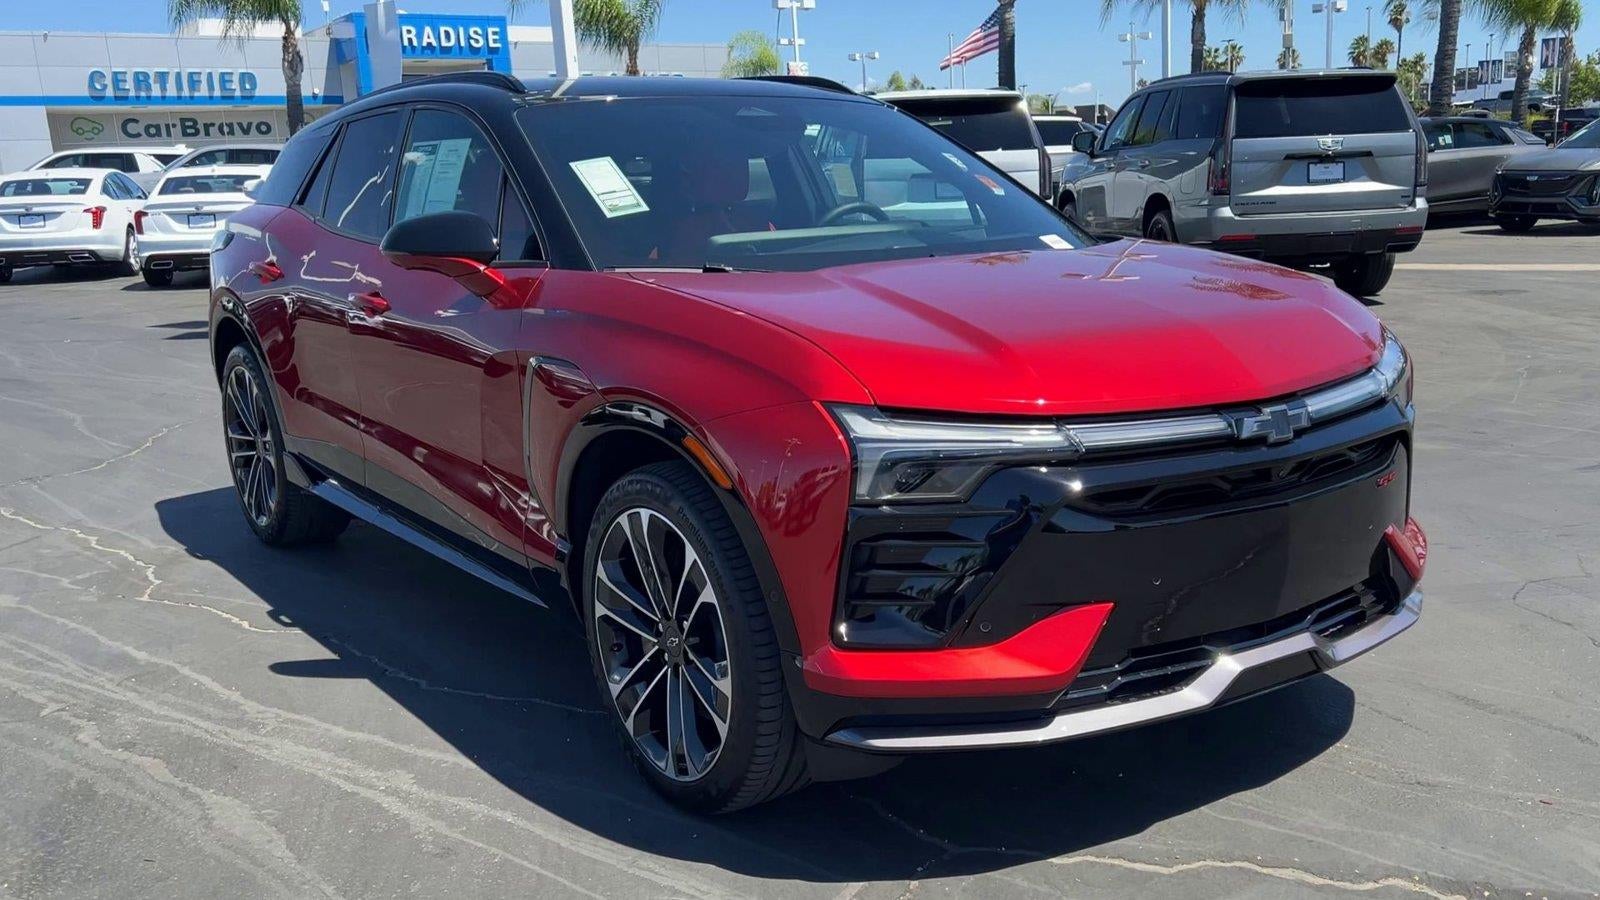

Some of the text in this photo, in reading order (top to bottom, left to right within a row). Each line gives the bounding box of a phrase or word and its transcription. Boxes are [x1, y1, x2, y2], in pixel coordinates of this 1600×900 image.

[400, 25, 502, 48] RADISE
[88, 69, 258, 97] CERTIFIED
[120, 117, 272, 138] CarBravo
